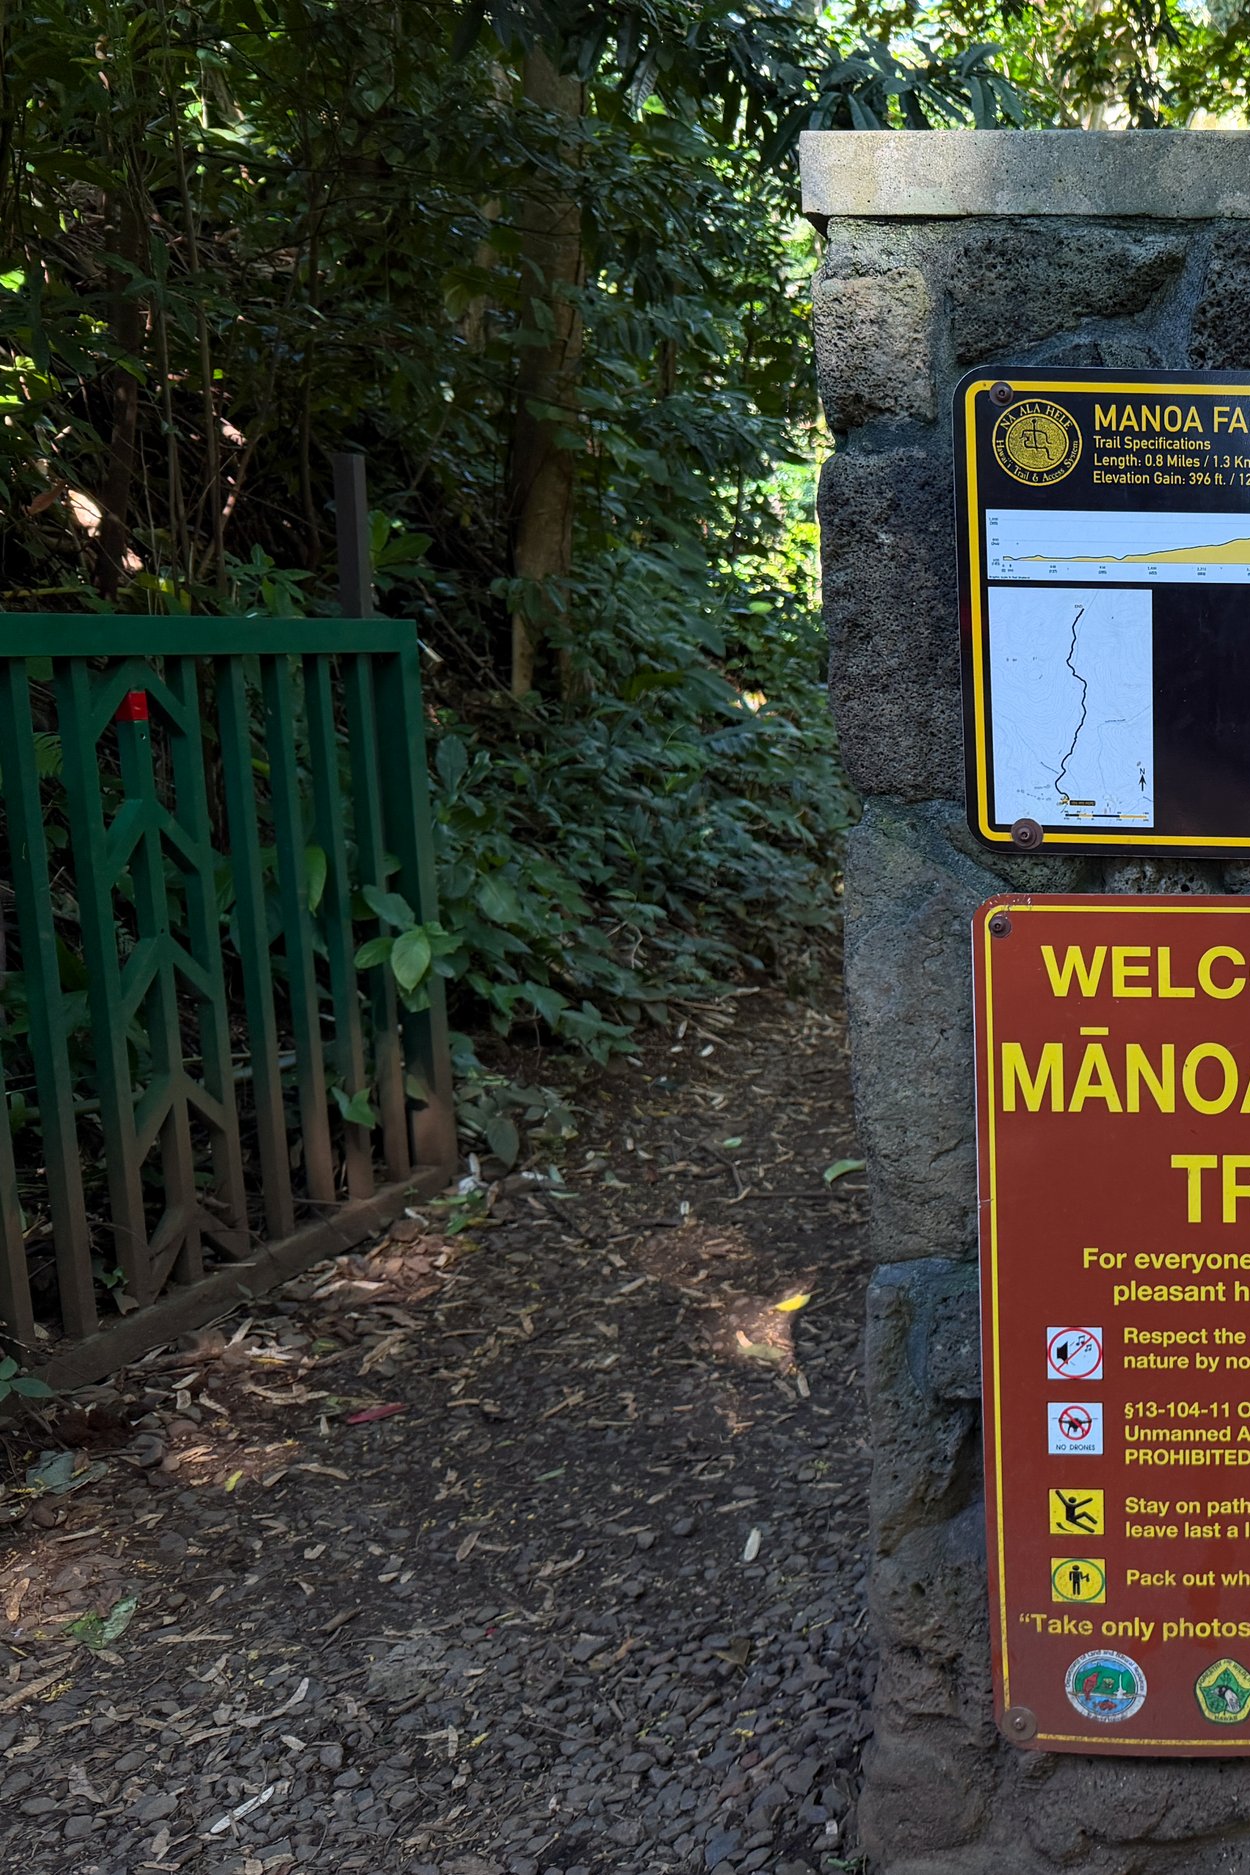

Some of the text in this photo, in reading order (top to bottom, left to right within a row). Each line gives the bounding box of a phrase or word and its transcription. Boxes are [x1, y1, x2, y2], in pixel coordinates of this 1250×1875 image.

[1020, 403, 1041, 416] ALA
[1045, 405, 1073, 430] HELE
[1094, 404, 1203, 433] MANOA
[1093, 436, 1211, 452] Trail Specifications
[1094, 453, 1142, 469] Length:
[1145, 454, 1163, 467] 0.8
[1167, 454, 1200, 468] Miles
[1203, 455, 1210, 468] /
[1213, 455, 1230, 468] 1.3
[1093, 471, 1150, 484] Elevation
[1153, 472, 1186, 485] Gain:
[1188, 473, 1211, 485] 396
[1214, 473, 1226, 485] ft.
[1229, 473, 1236, 486] /
[1083, 1248, 1127, 1270] For
[1113, 1280, 1226, 1306] pleasant
[1123, 1327, 1208, 1347] Respect
[1213, 1328, 1246, 1345] the
[1123, 1353, 1189, 1370] nature
[1195, 1352, 1219, 1373] by
[1124, 1401, 1230, 1420] §13-104-11
[1124, 1425, 1231, 1442] Unmanned
[1125, 1497, 1169, 1518] Stay
[1175, 1501, 1201, 1514] on
[1125, 1521, 1179, 1539] leave
[1184, 1522, 1221, 1539] last
[1226, 1526, 1239, 1539] a
[1126, 1570, 1176, 1587] Pack
[1182, 1571, 1215, 1587] out
[1019, 1613, 1094, 1636] “Take
[1101, 1617, 1155, 1642] only
